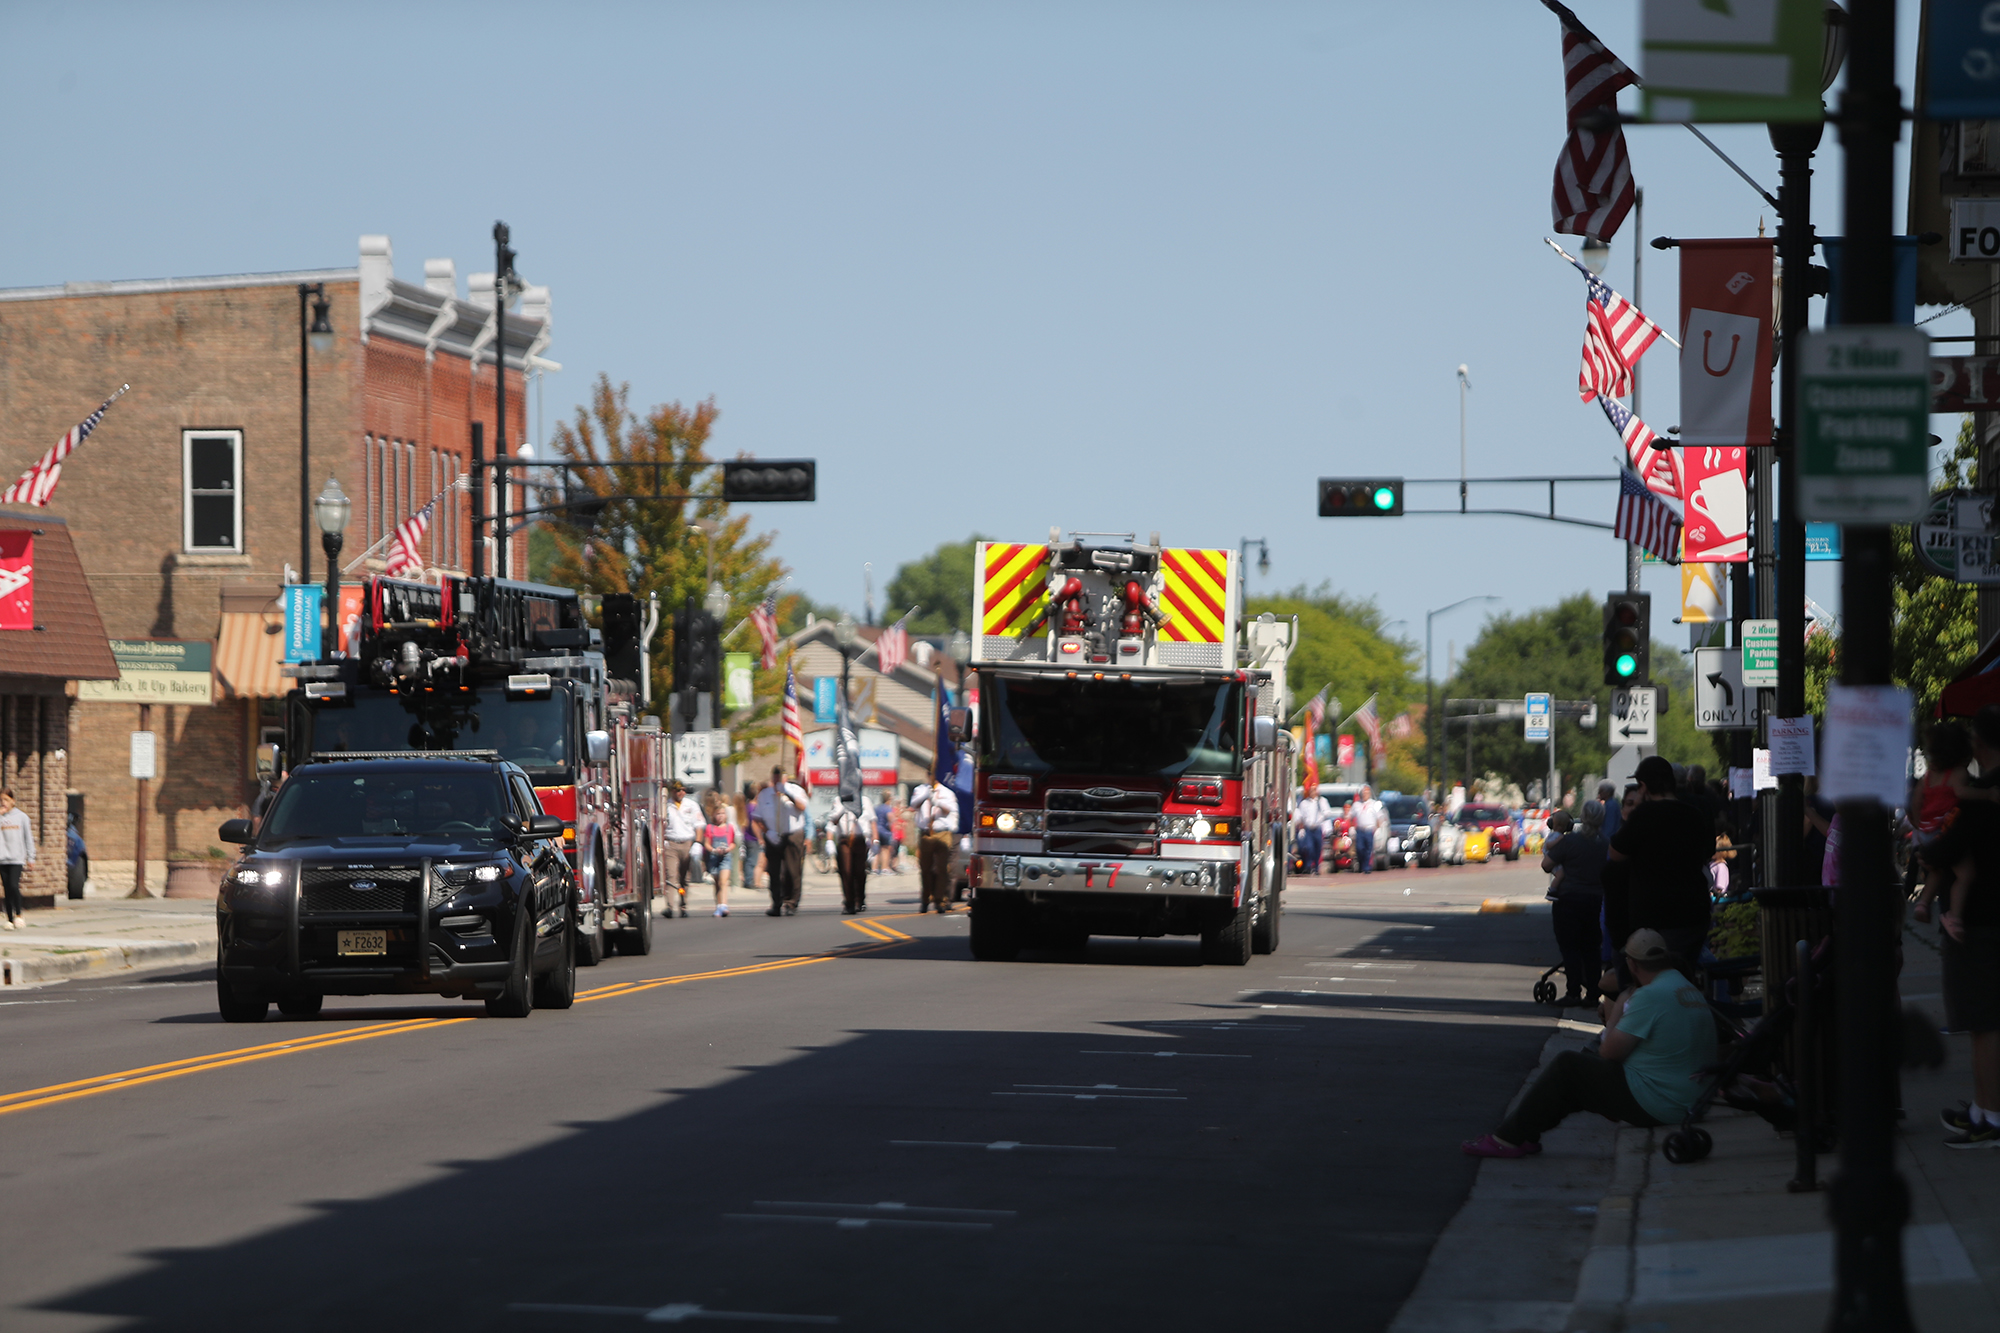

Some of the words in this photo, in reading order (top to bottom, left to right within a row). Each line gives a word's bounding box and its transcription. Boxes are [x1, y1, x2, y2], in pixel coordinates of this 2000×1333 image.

[1929, 362, 2000, 404] PI
[293, 588, 303, 649] DOWNTOWN
[1752, 626, 1757, 634] 2
[1758, 626, 1777, 634] Hour
[1745, 638, 1779, 648] Custome
[1755, 659, 1775, 668] Zone
[169, 680, 207, 695] Bakery
[1617, 692, 1650, 706] ONE
[1617, 709, 1650, 722] WAY
[1702, 709, 1738, 722] ONLY
[1772, 727, 1809, 735] PARKING
[1078, 862, 1124, 888] T7
[355, 936, 383, 949] F2632
